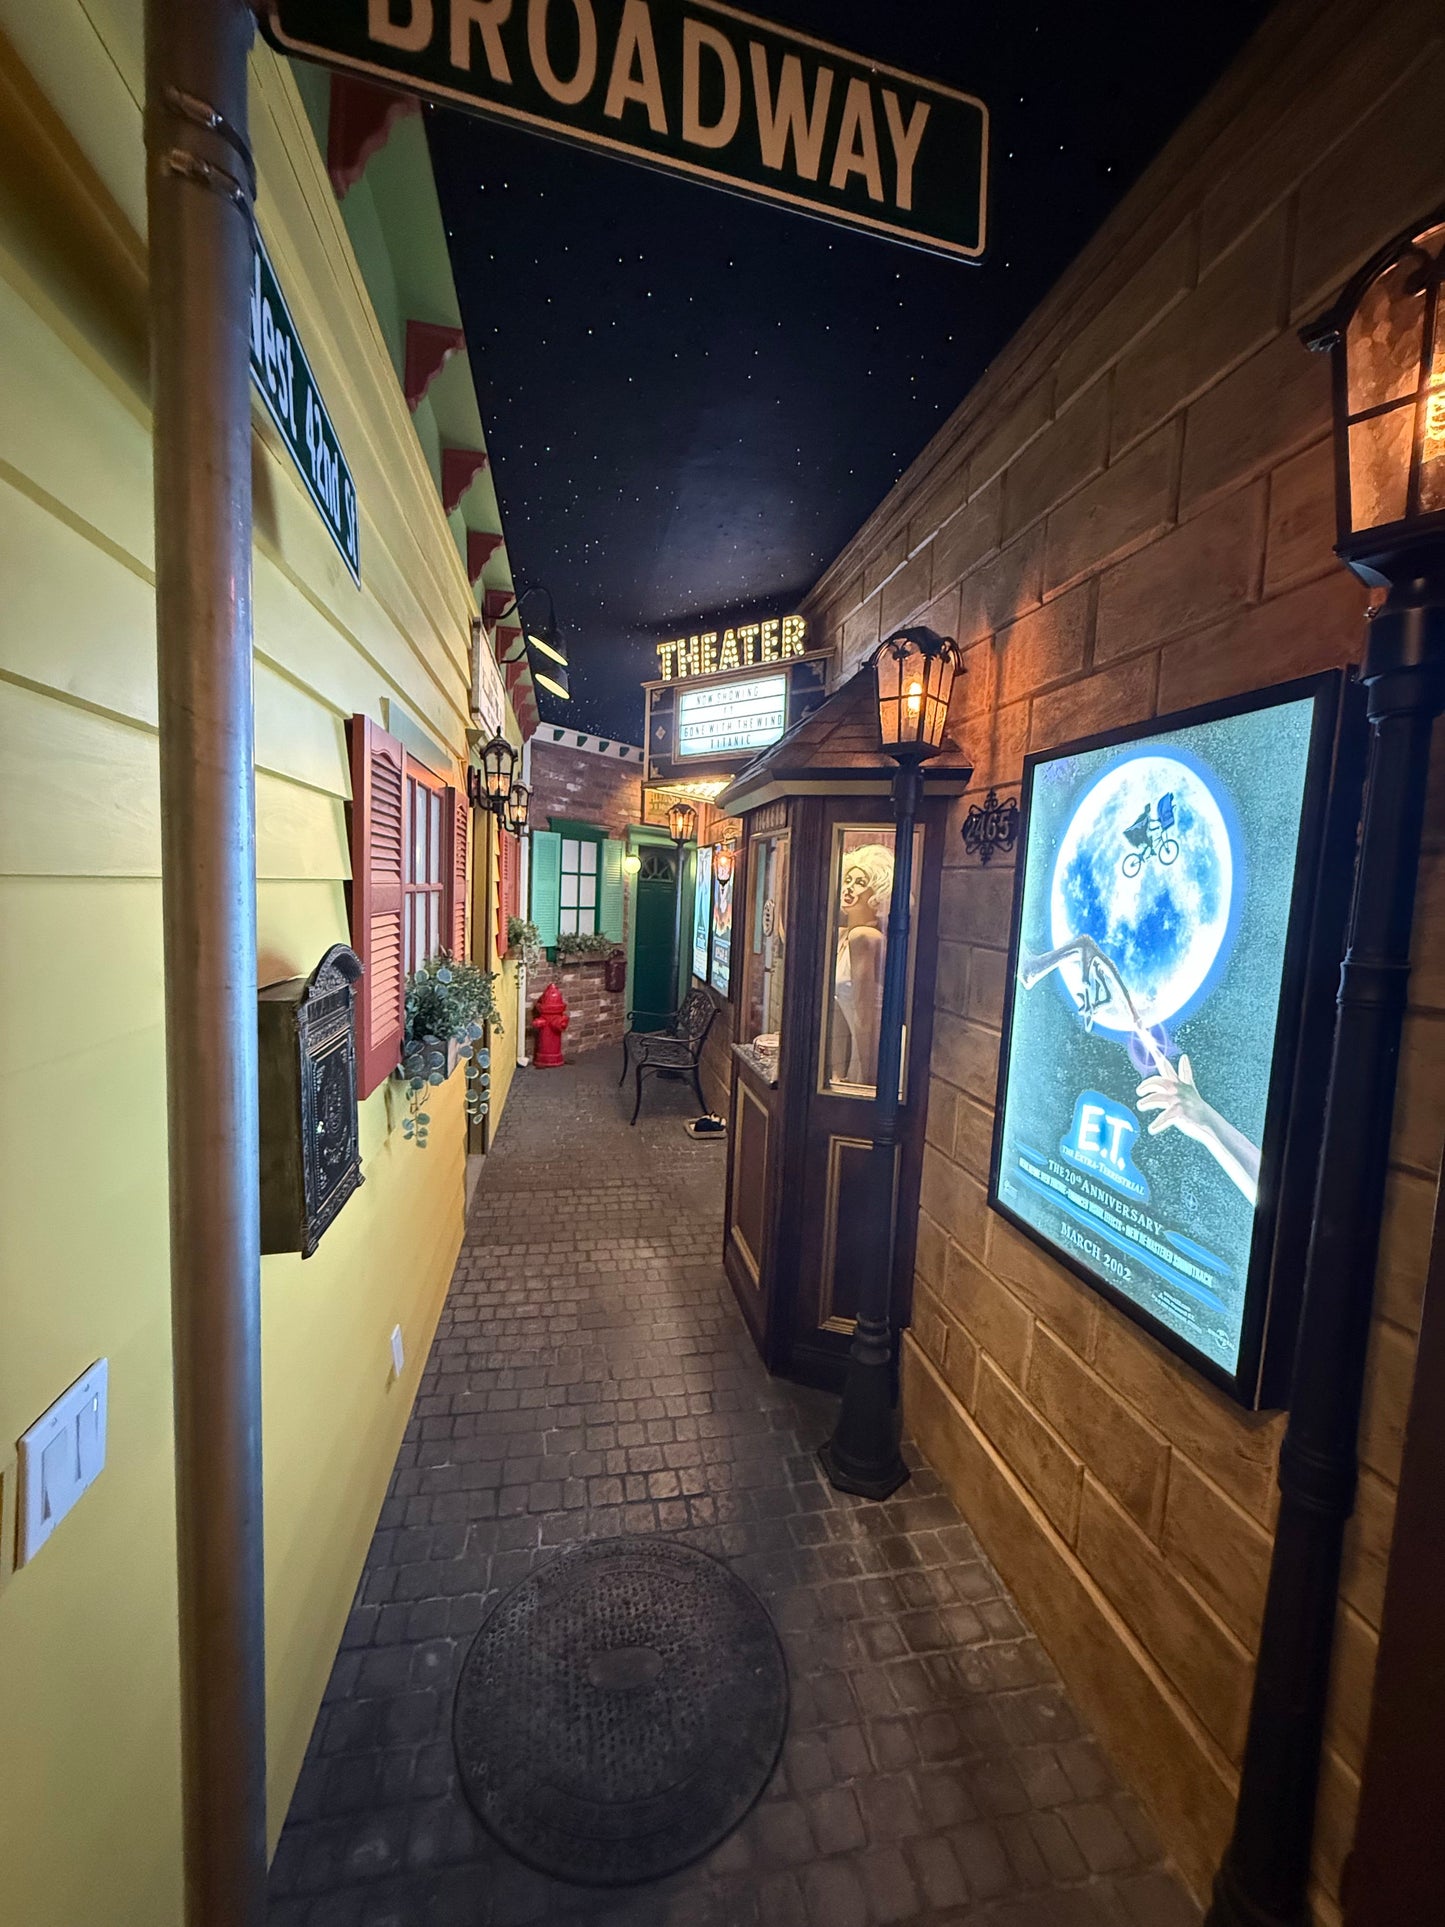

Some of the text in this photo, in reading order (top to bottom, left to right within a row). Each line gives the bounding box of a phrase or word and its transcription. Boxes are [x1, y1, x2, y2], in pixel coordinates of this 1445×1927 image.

[306, 385, 341, 532] 42nd
[345, 477, 358, 569] St
[656, 614, 807, 681] THEATER
[696, 686, 759, 705] NOW SHOWING
[684, 714, 783, 738] GONE WITH THE WIND
[710, 734, 752, 749] TITANIC
[966, 813, 1009, 842] 2465
[1078, 1104, 1134, 1171] E.T.
[1048, 1159, 1065, 1178] THE
[1081, 1179, 1164, 1236] ANNIVERSARY
[1060, 1221, 1132, 1281] MARCH 2002
